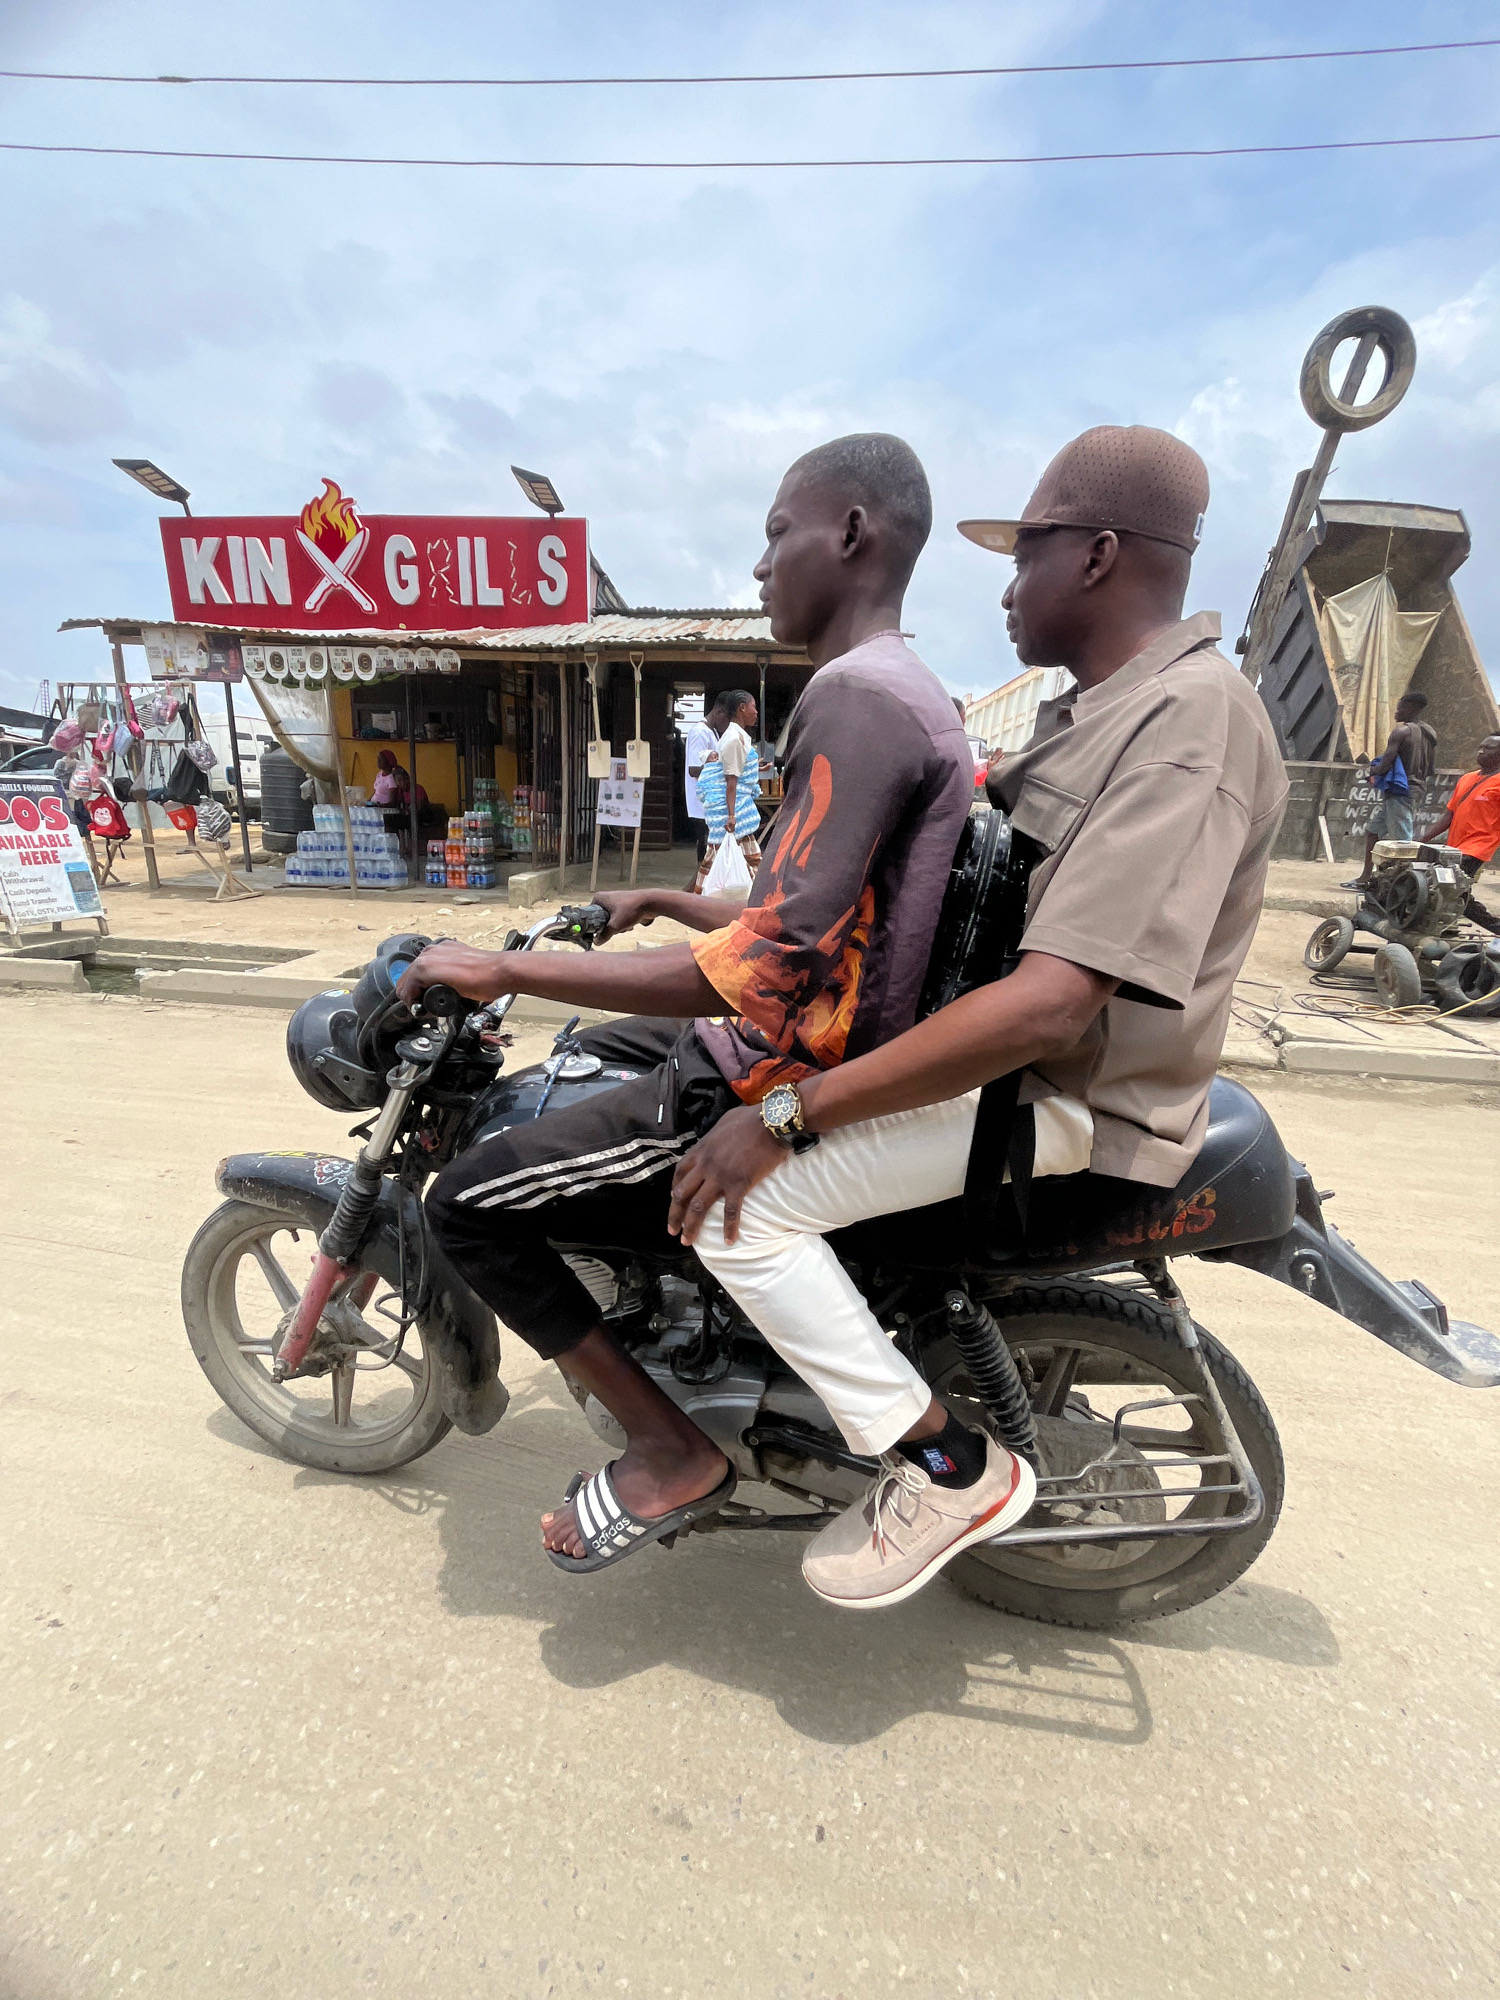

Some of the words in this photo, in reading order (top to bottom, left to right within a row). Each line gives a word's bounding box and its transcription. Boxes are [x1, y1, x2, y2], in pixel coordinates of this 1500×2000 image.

[0, 834, 72, 850] AVAILABLE
[19, 850, 61, 866] HERE
[4, 875, 44, 884] Withdrawal
[26, 887, 52, 896] Deposit
[30, 897, 58, 905] Transfer
[923, 1448, 948, 1471] SPORT
[591, 1516, 631, 1549] adidas
